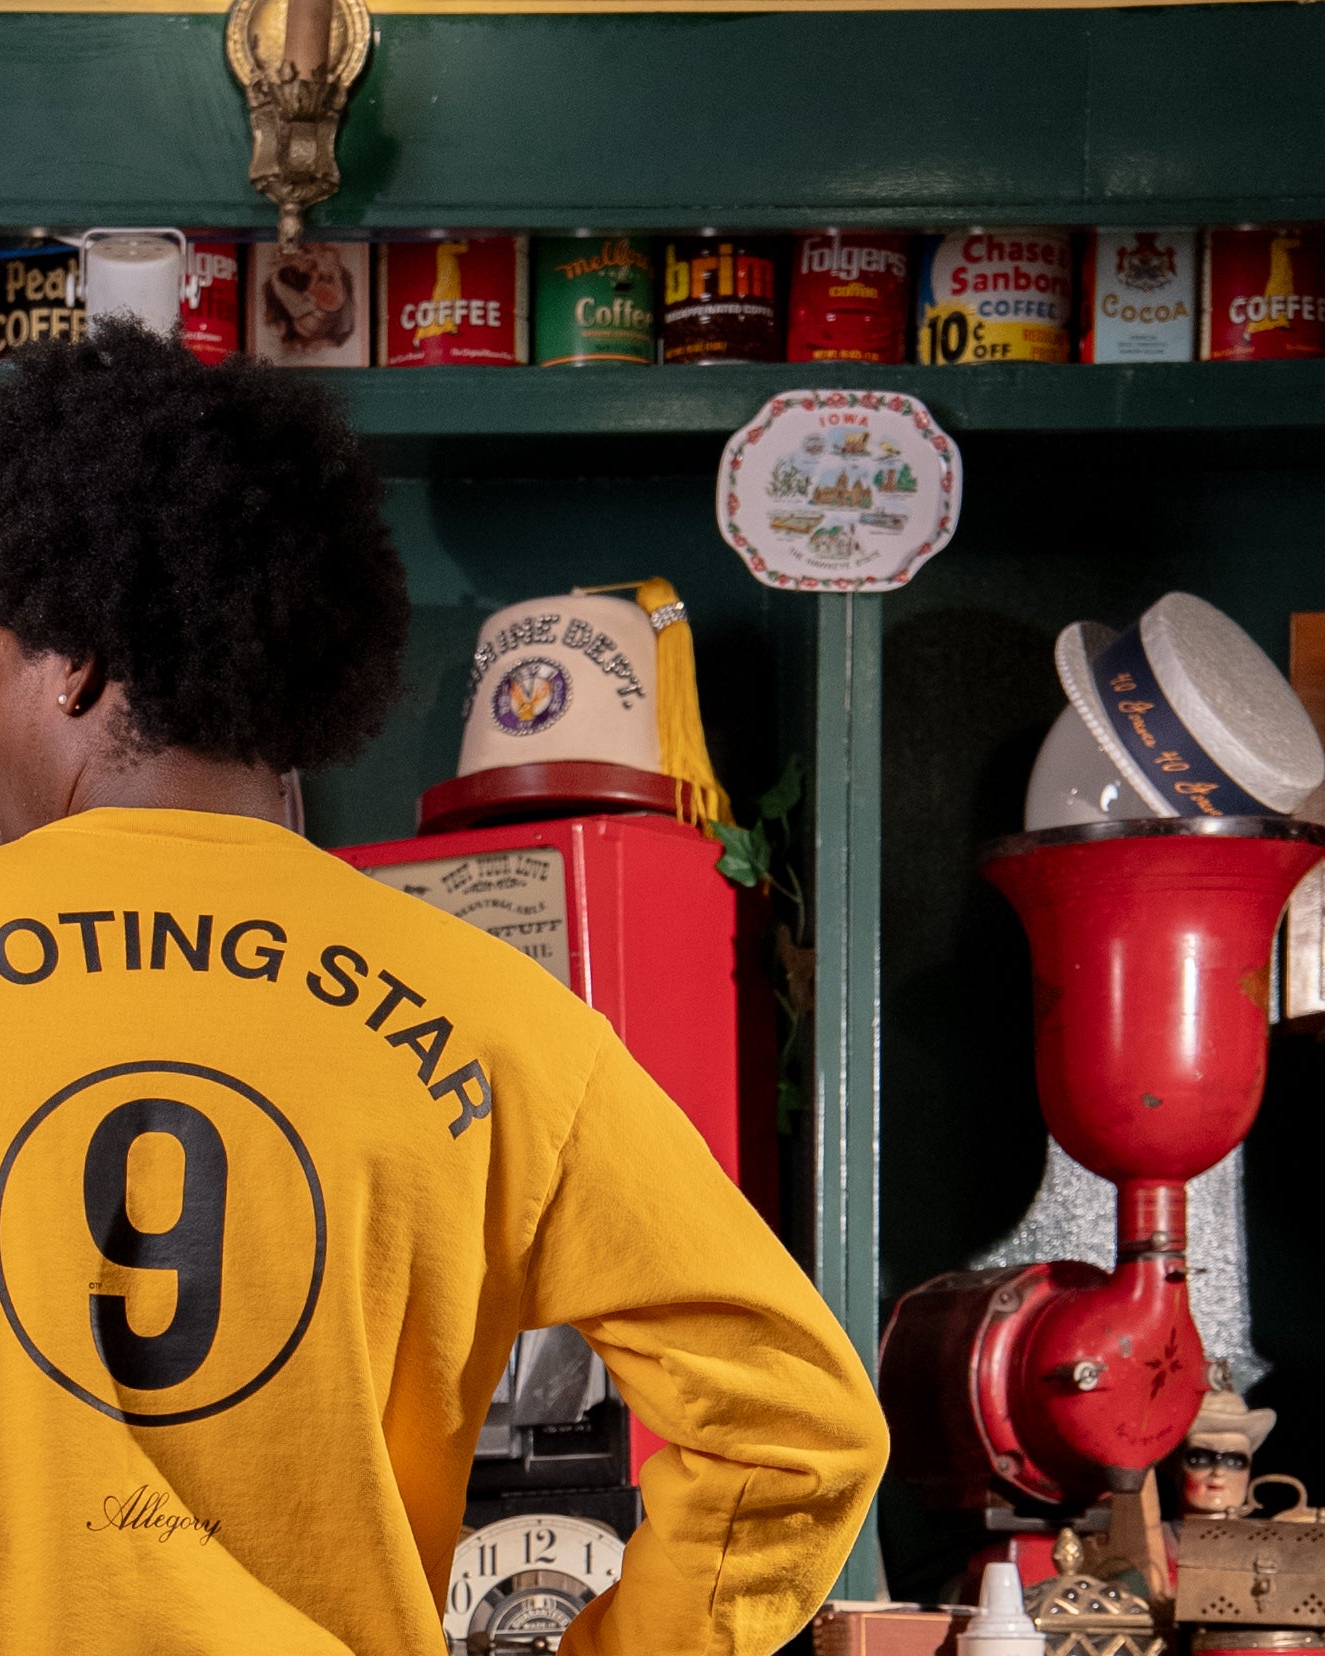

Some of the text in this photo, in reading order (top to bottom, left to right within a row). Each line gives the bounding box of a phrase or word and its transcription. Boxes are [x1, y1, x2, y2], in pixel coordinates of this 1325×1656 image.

[665, 243, 774, 305] brim
[400, 299, 501, 330] COFFEE
[974, 344, 1011, 358] OFF
[819, 412, 870, 428] IOWA
[563, 617, 646, 711] DEPT.
[304, 943, 495, 1141] STAR
[83, 1097, 229, 1392] 9
[86, 1483, 224, 1540] Allegory
[477, 1542, 499, 1577] 11
[523, 1528, 557, 1565] 12
[583, 1541, 594, 1575] 1
